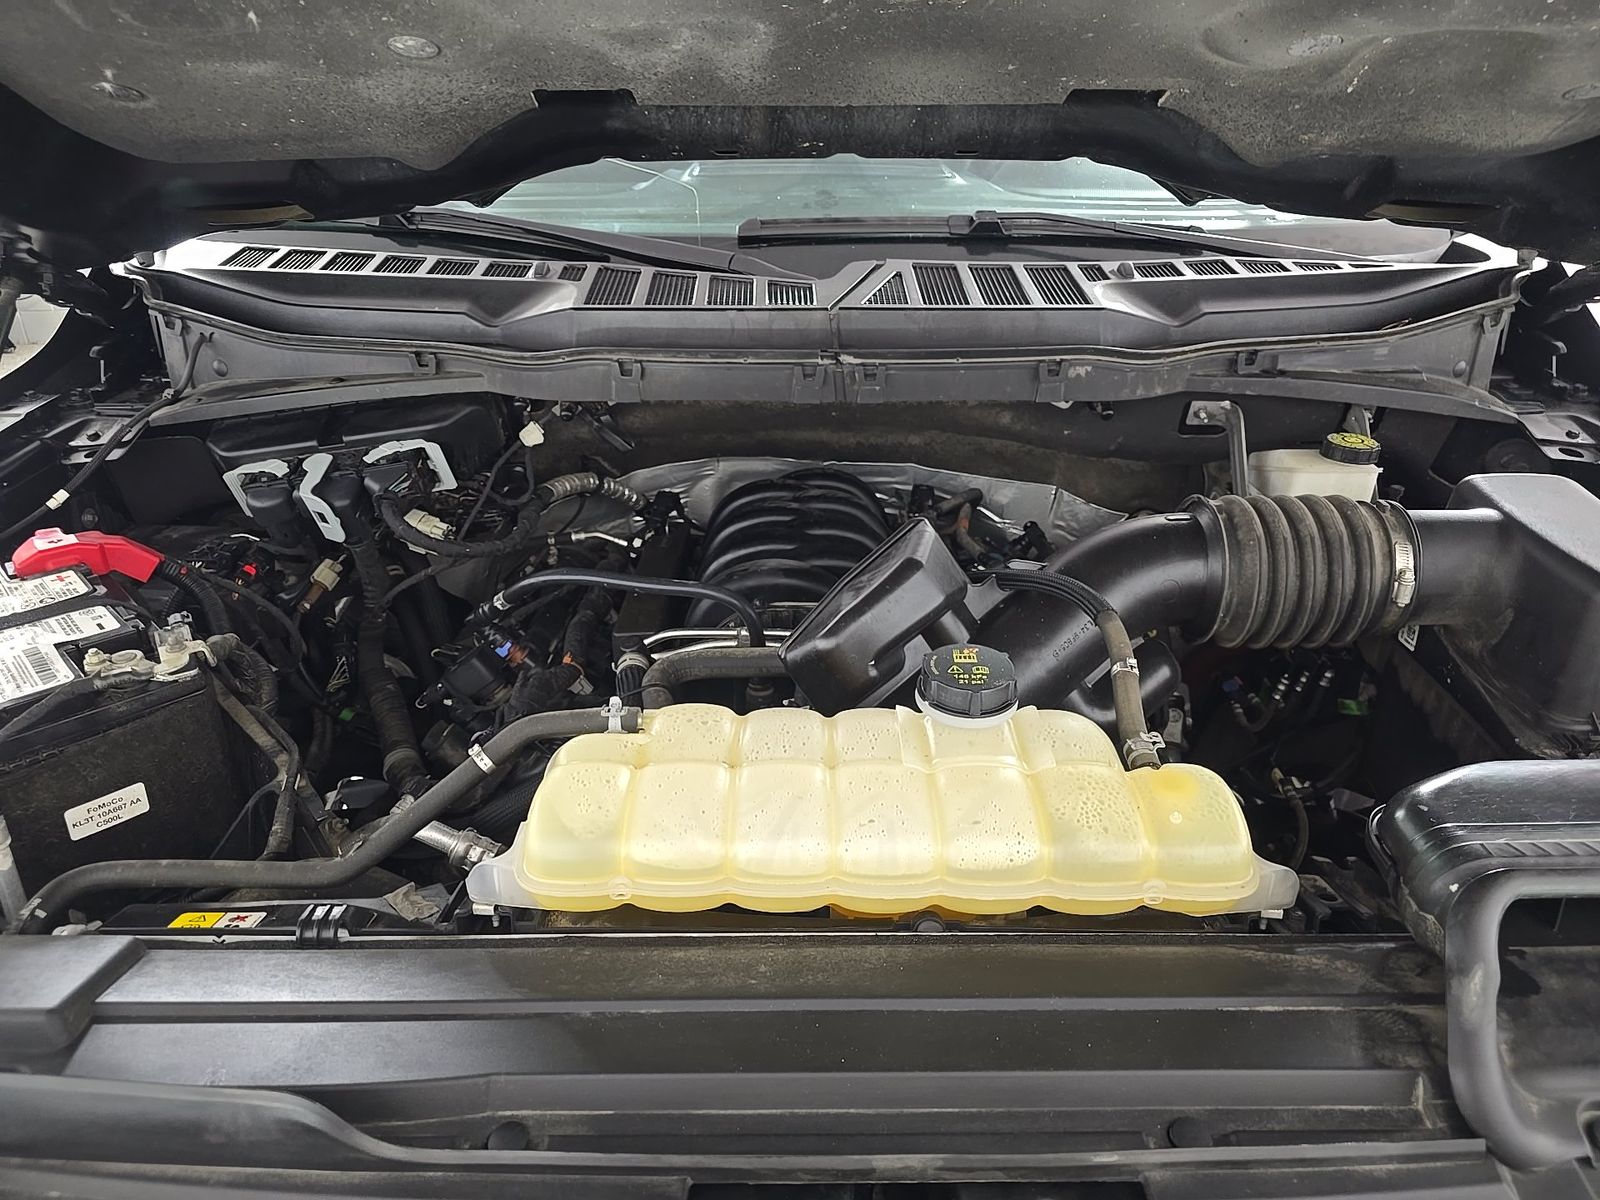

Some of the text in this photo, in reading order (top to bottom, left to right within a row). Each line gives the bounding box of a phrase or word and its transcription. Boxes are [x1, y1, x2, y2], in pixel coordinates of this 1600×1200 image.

[72, 816, 95, 829] KL3T
[129, 797, 142, 807] AA
[86, 796, 123, 814] FoMoCo
[96, 814, 123, 828] C500L
